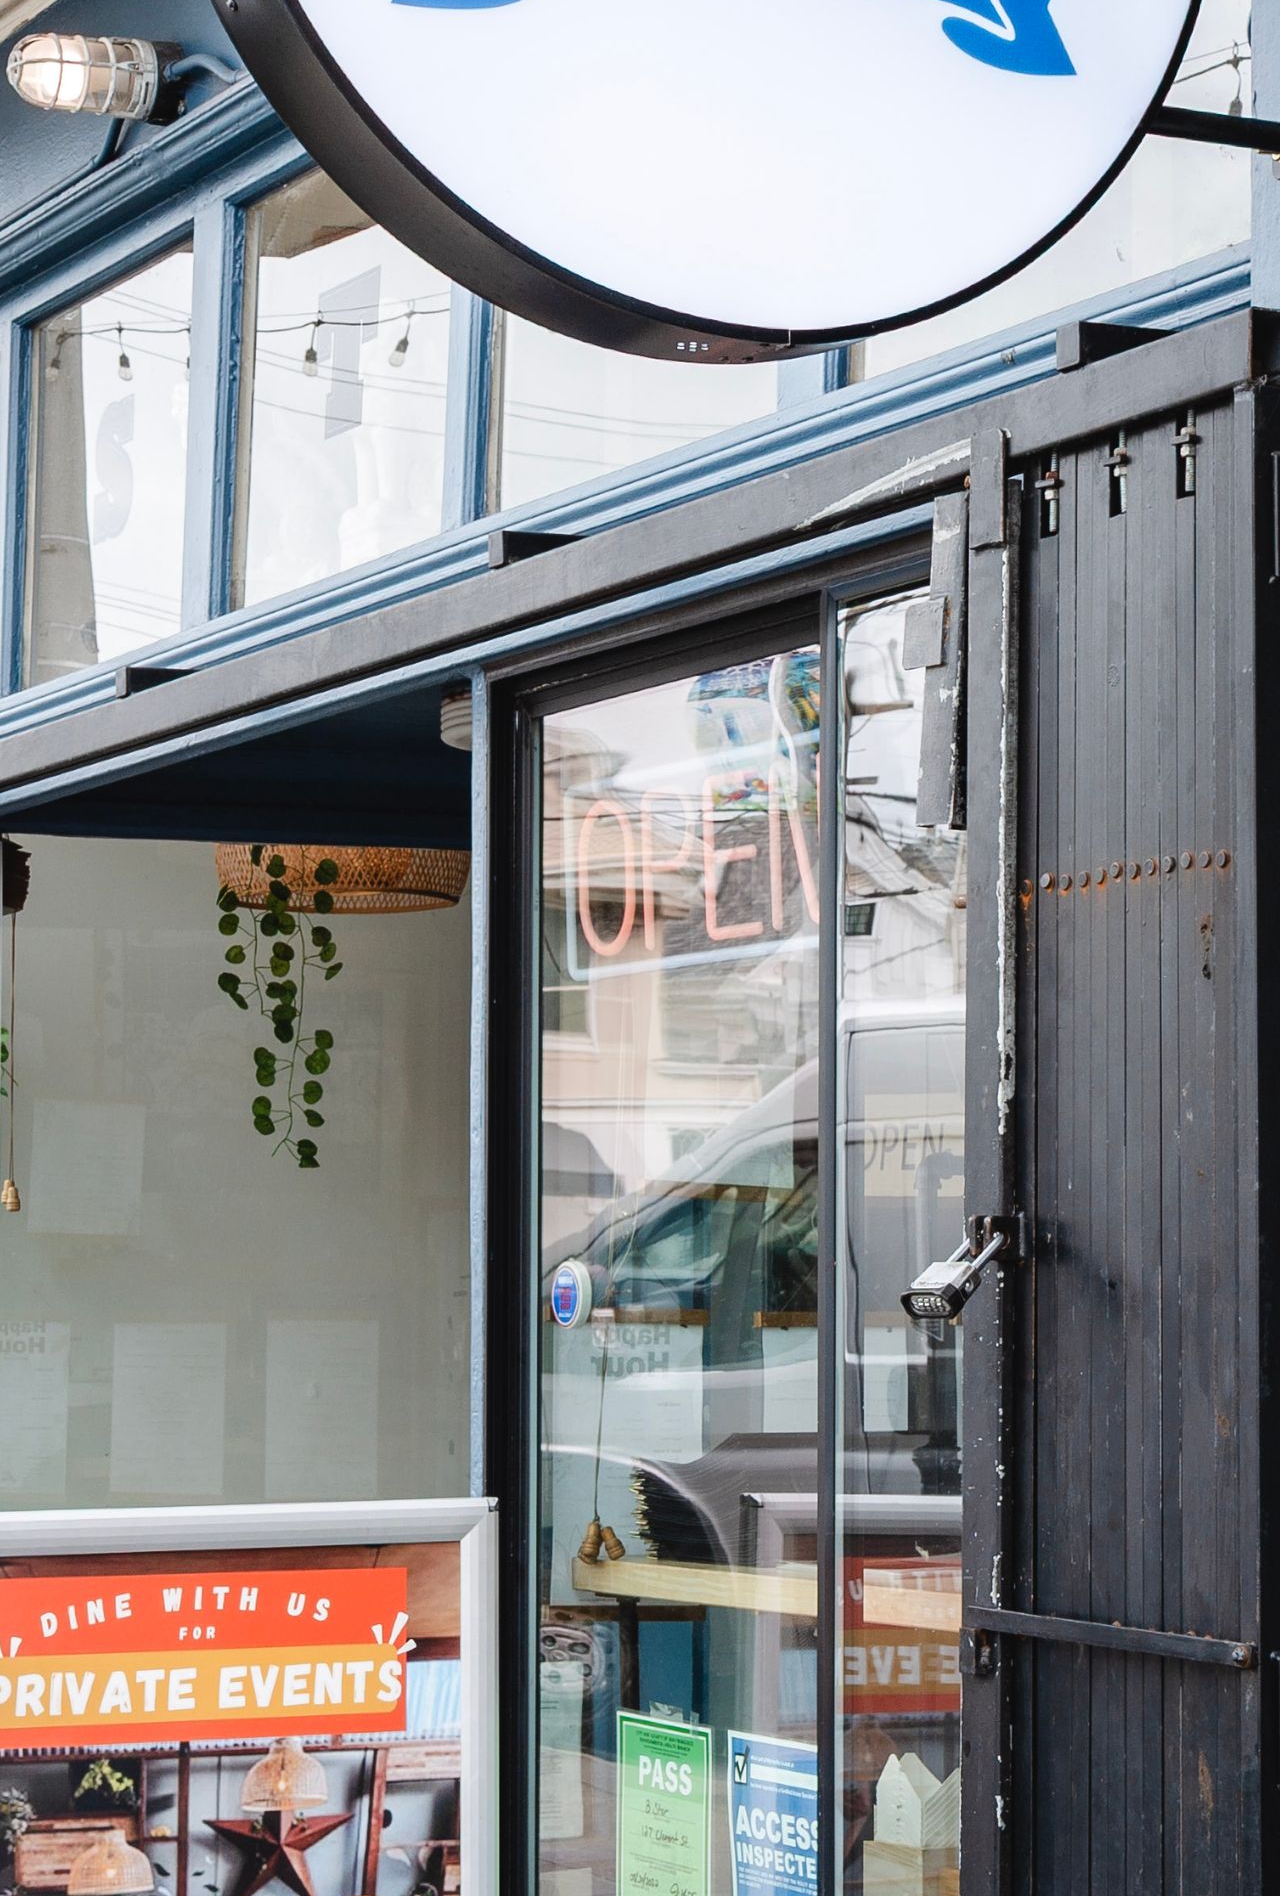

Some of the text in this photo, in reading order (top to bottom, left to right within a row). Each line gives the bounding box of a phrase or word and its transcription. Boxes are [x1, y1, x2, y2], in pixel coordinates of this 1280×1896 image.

[579, 751, 820, 956] OPEN
[39, 1585, 331, 1638] DINE WITH US
[178, 1625, 216, 1640] FOR
[218, 1660, 402, 1709] EVENTS
[638, 1754, 693, 1796] PASS
[736, 1841, 817, 1880] INSPECTE
